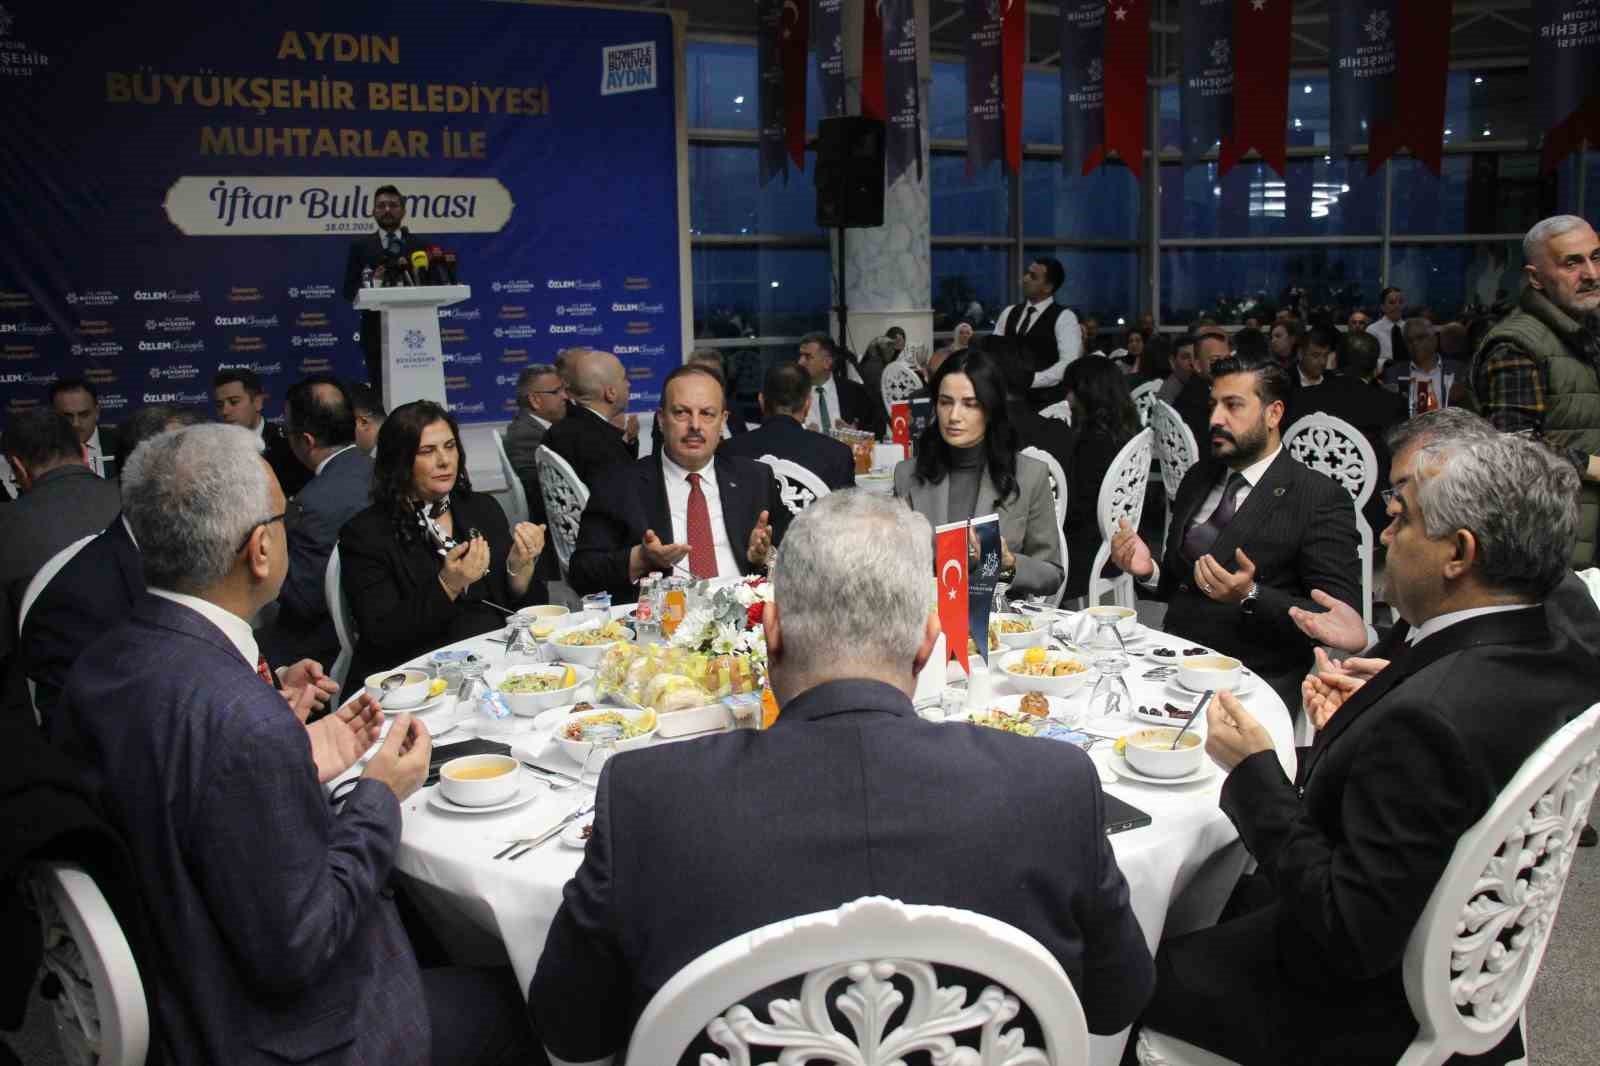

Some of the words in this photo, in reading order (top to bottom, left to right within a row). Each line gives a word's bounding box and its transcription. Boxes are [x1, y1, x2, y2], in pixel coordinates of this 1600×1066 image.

[277, 31, 399, 63] AYDIN
[105, 65, 354, 117] BÜYÜKŞEHİR
[367, 81, 549, 115] BELEDİYESİ
[607, 67, 652, 89] AYDIN
[200, 127, 429, 159] MUHTARLAR
[443, 125, 487, 159] İLE
[210, 180, 292, 226] İftar
[301, 185, 475, 219] Buluması
